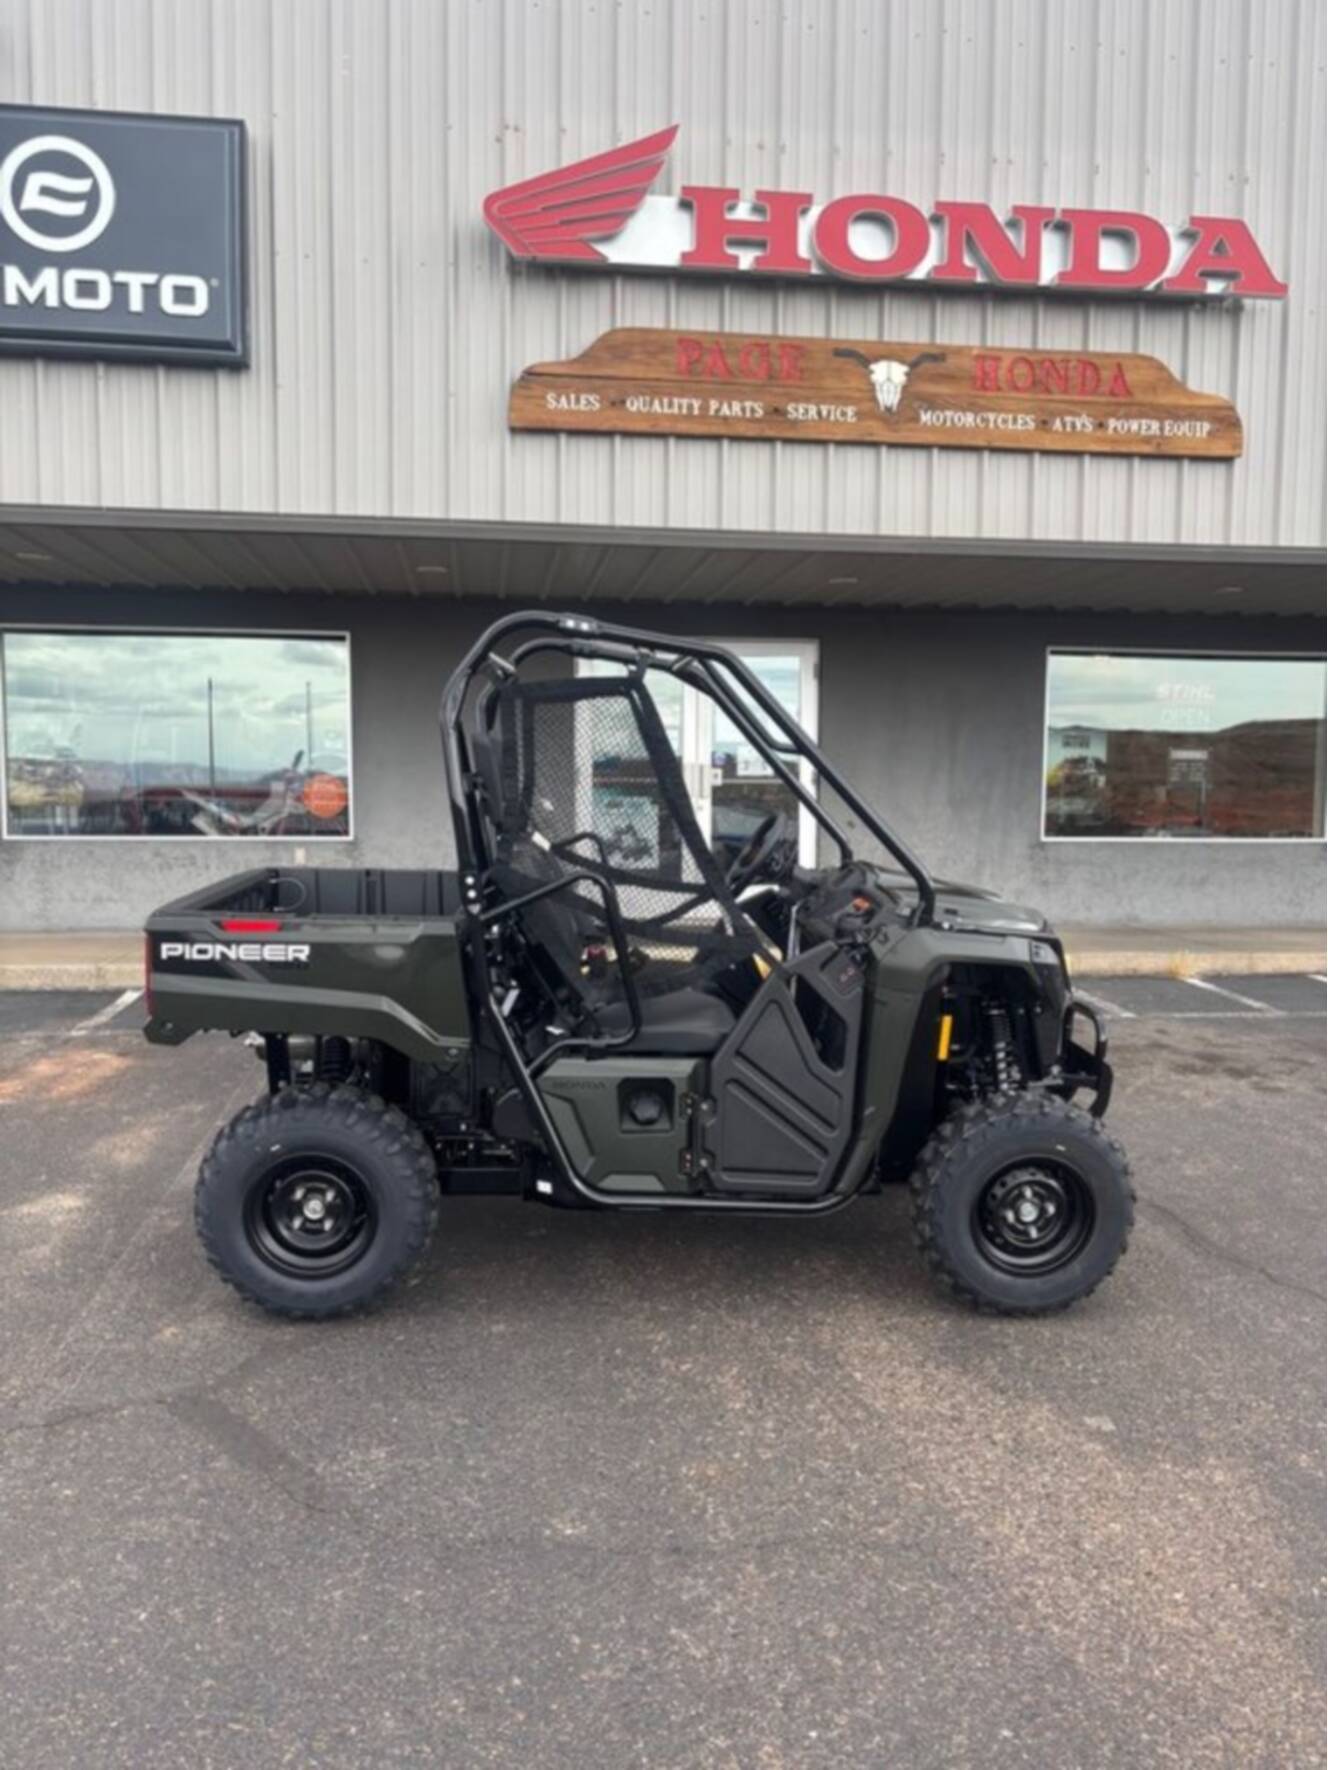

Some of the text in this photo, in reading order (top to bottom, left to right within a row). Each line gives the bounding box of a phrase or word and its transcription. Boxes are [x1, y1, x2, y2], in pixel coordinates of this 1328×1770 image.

[679, 184, 1288, 299] HONDA
[676, 337, 807, 382] PAGE
[973, 353, 1133, 397] HONDA
[546, 392, 858, 423] SALES QUALITY PARTS SERVICE
[919, 409, 1036, 431] MOTORCYCLES
[1107, 417, 1161, 436] POWER
[1163, 419, 1211, 438] EQUIP
[160, 943, 311, 963] PIONEER
